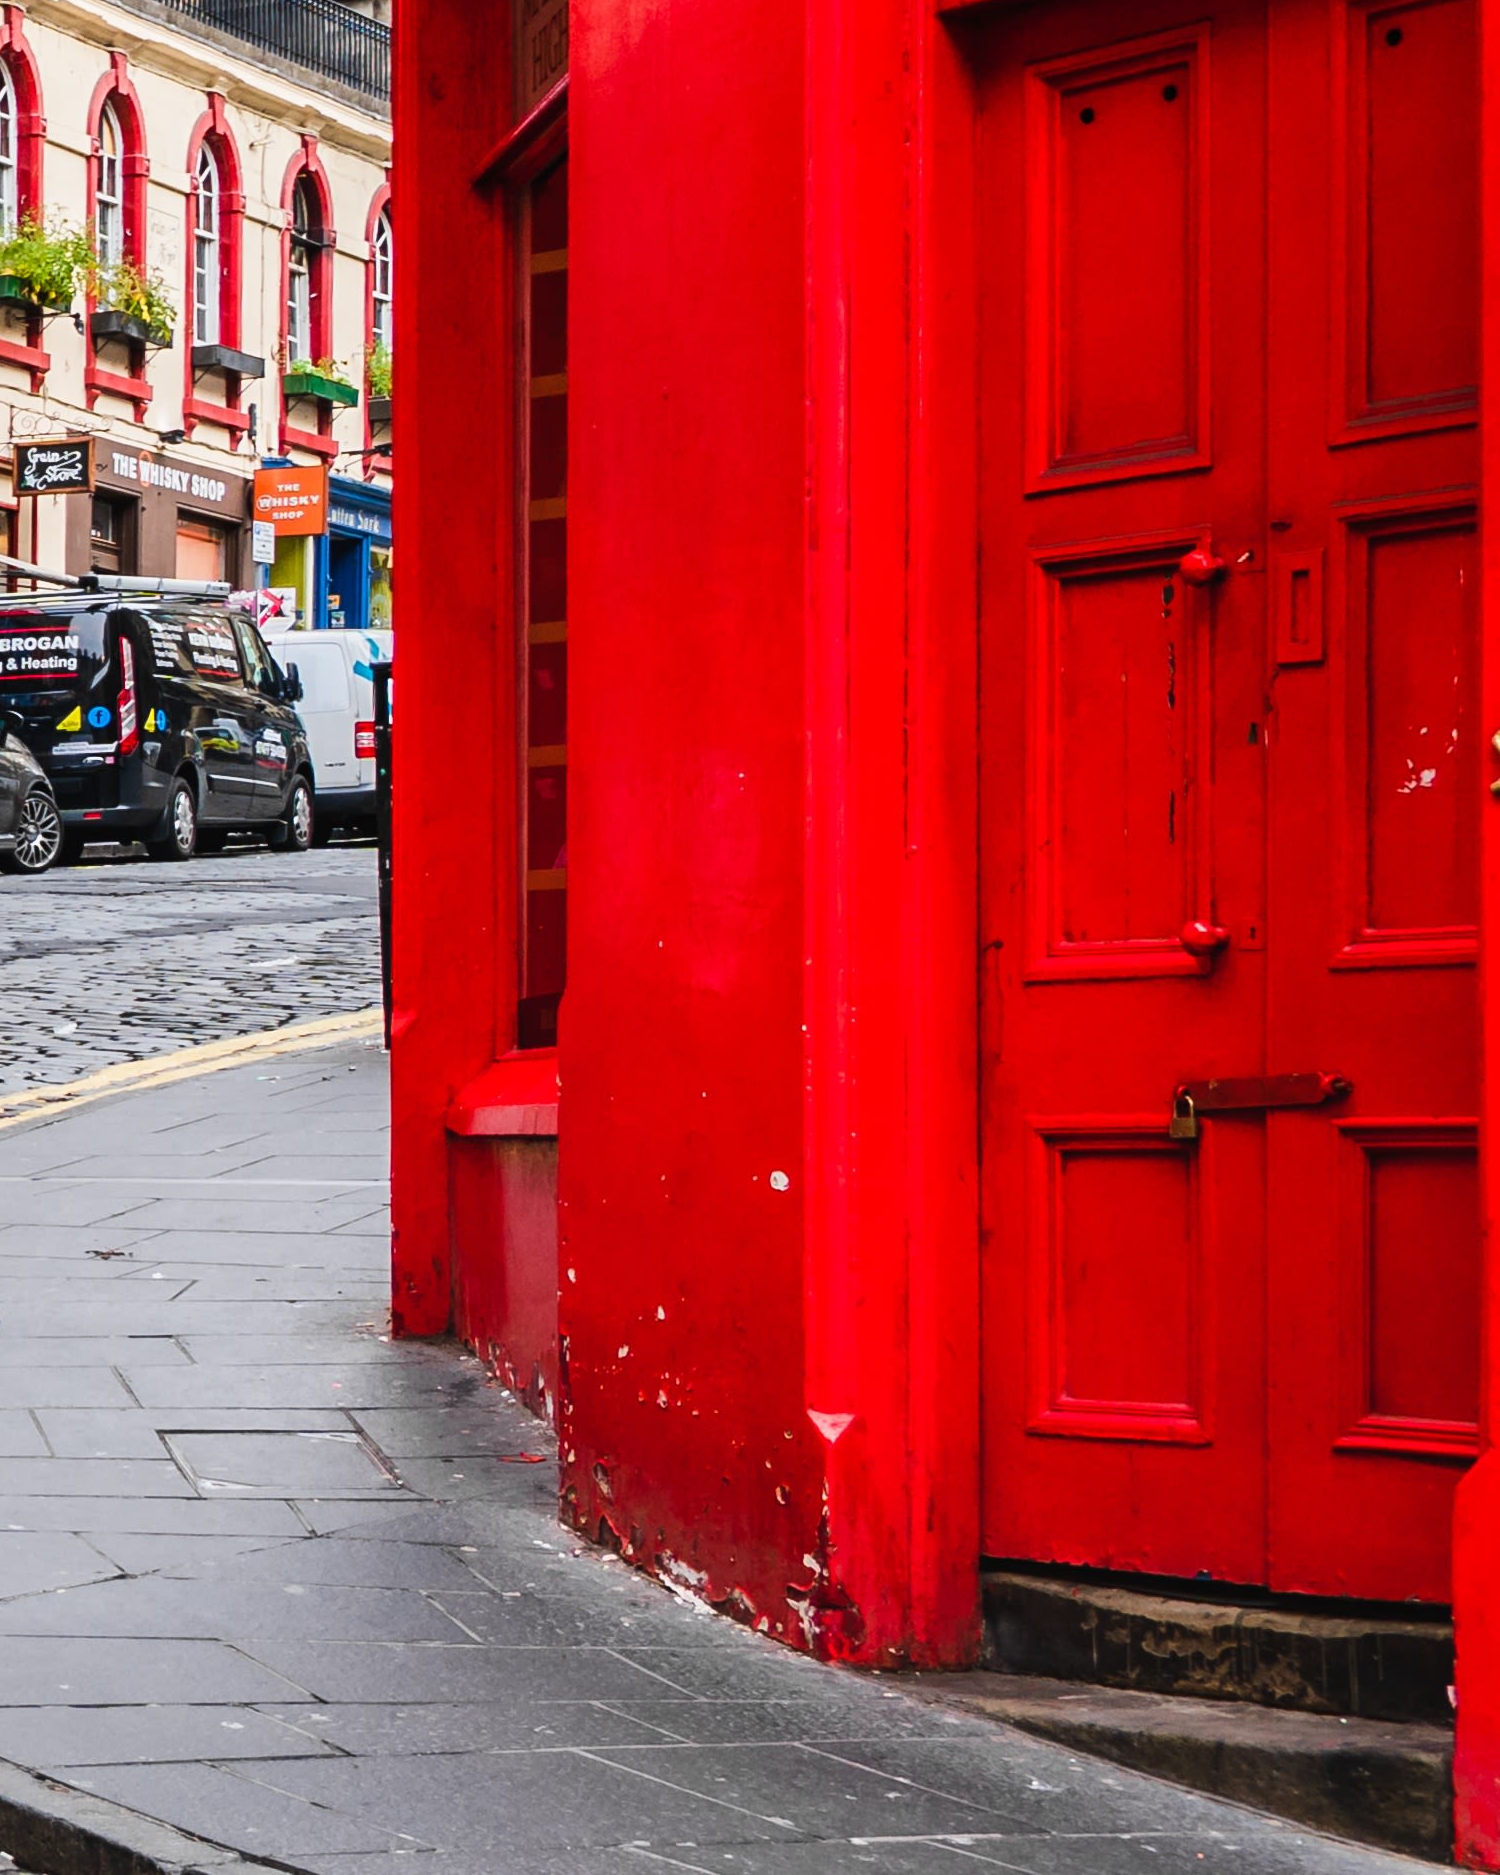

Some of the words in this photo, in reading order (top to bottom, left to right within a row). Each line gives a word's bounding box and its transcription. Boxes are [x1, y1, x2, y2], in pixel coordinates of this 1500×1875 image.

[112, 452, 138, 480] THE
[139, 459, 191, 493] WHISKY
[191, 474, 226, 502] SHOP
[276, 483, 300, 493] THE
[257, 494, 320, 511] WHISKY
[271, 511, 305, 520] SHOP
[6, 658, 18, 671] &
[21, 656, 78, 671] Heating
